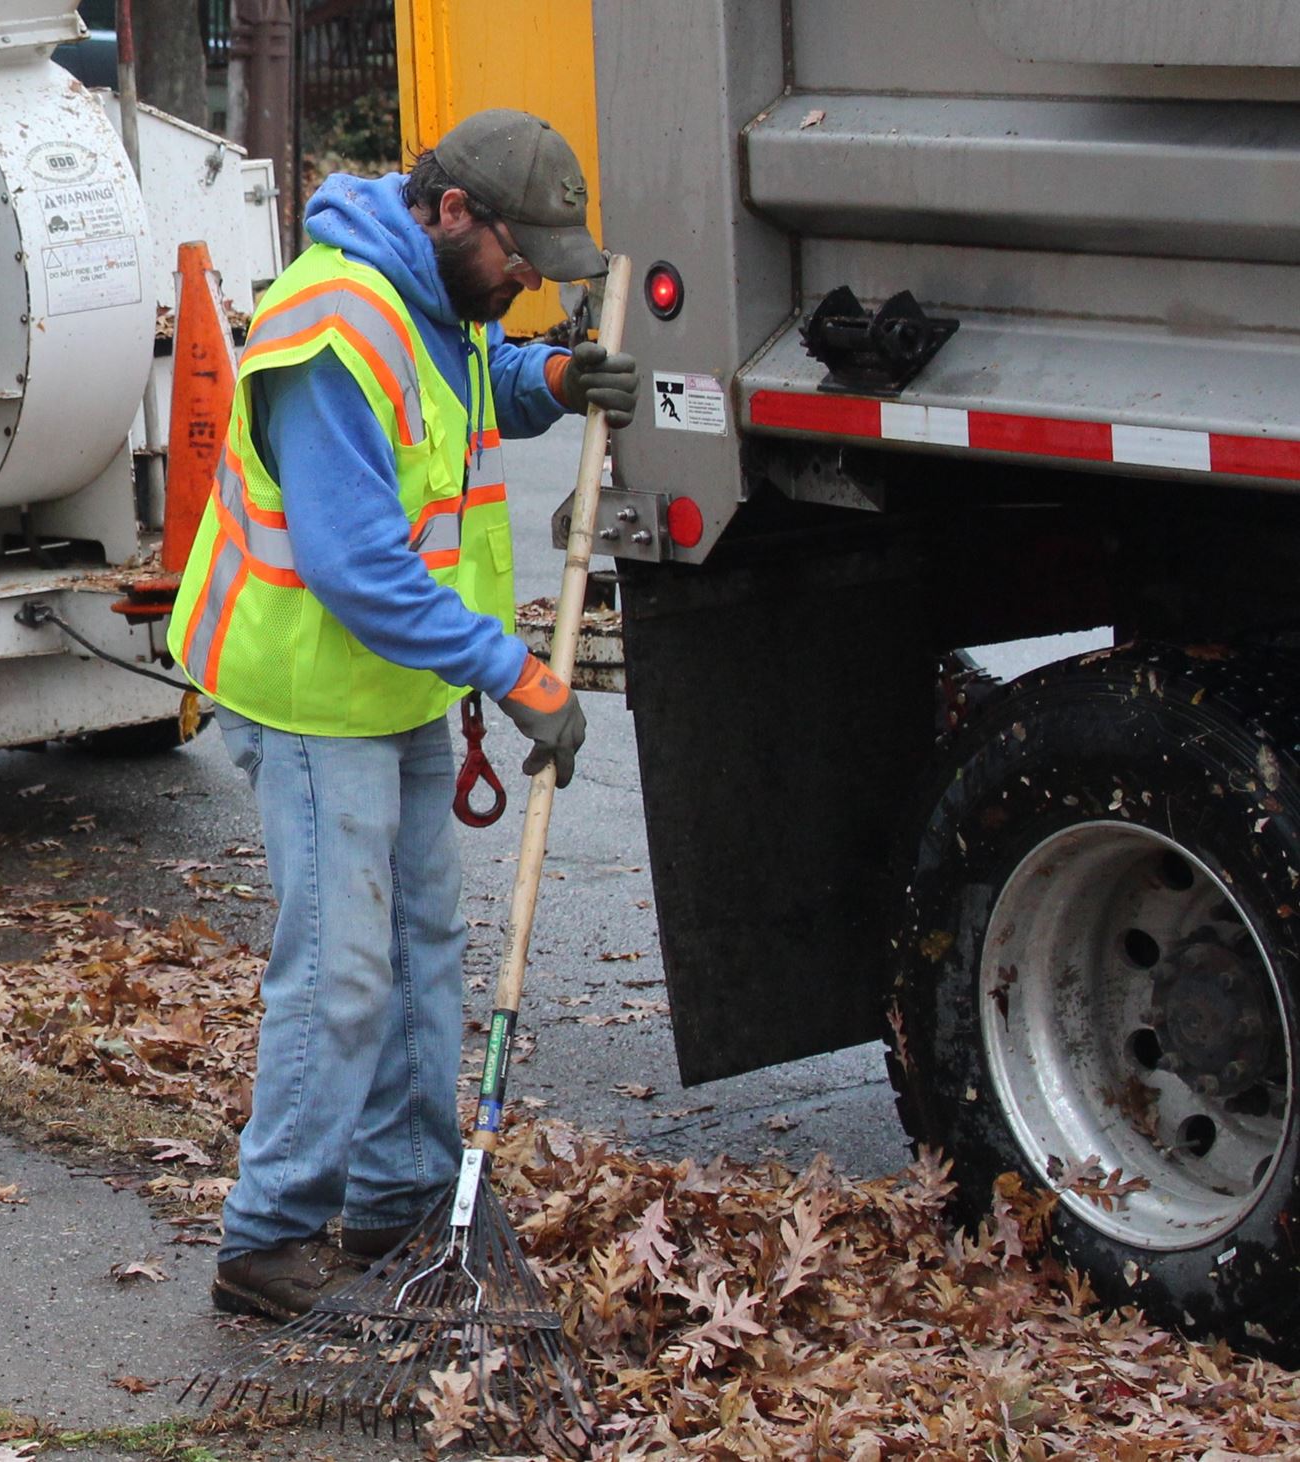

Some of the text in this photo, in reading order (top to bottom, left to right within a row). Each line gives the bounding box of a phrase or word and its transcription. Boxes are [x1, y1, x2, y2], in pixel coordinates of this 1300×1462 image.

[55, 187, 113, 205] WARNING
[49, 271, 59, 279] DO
[60, 269, 74, 277] NOT
